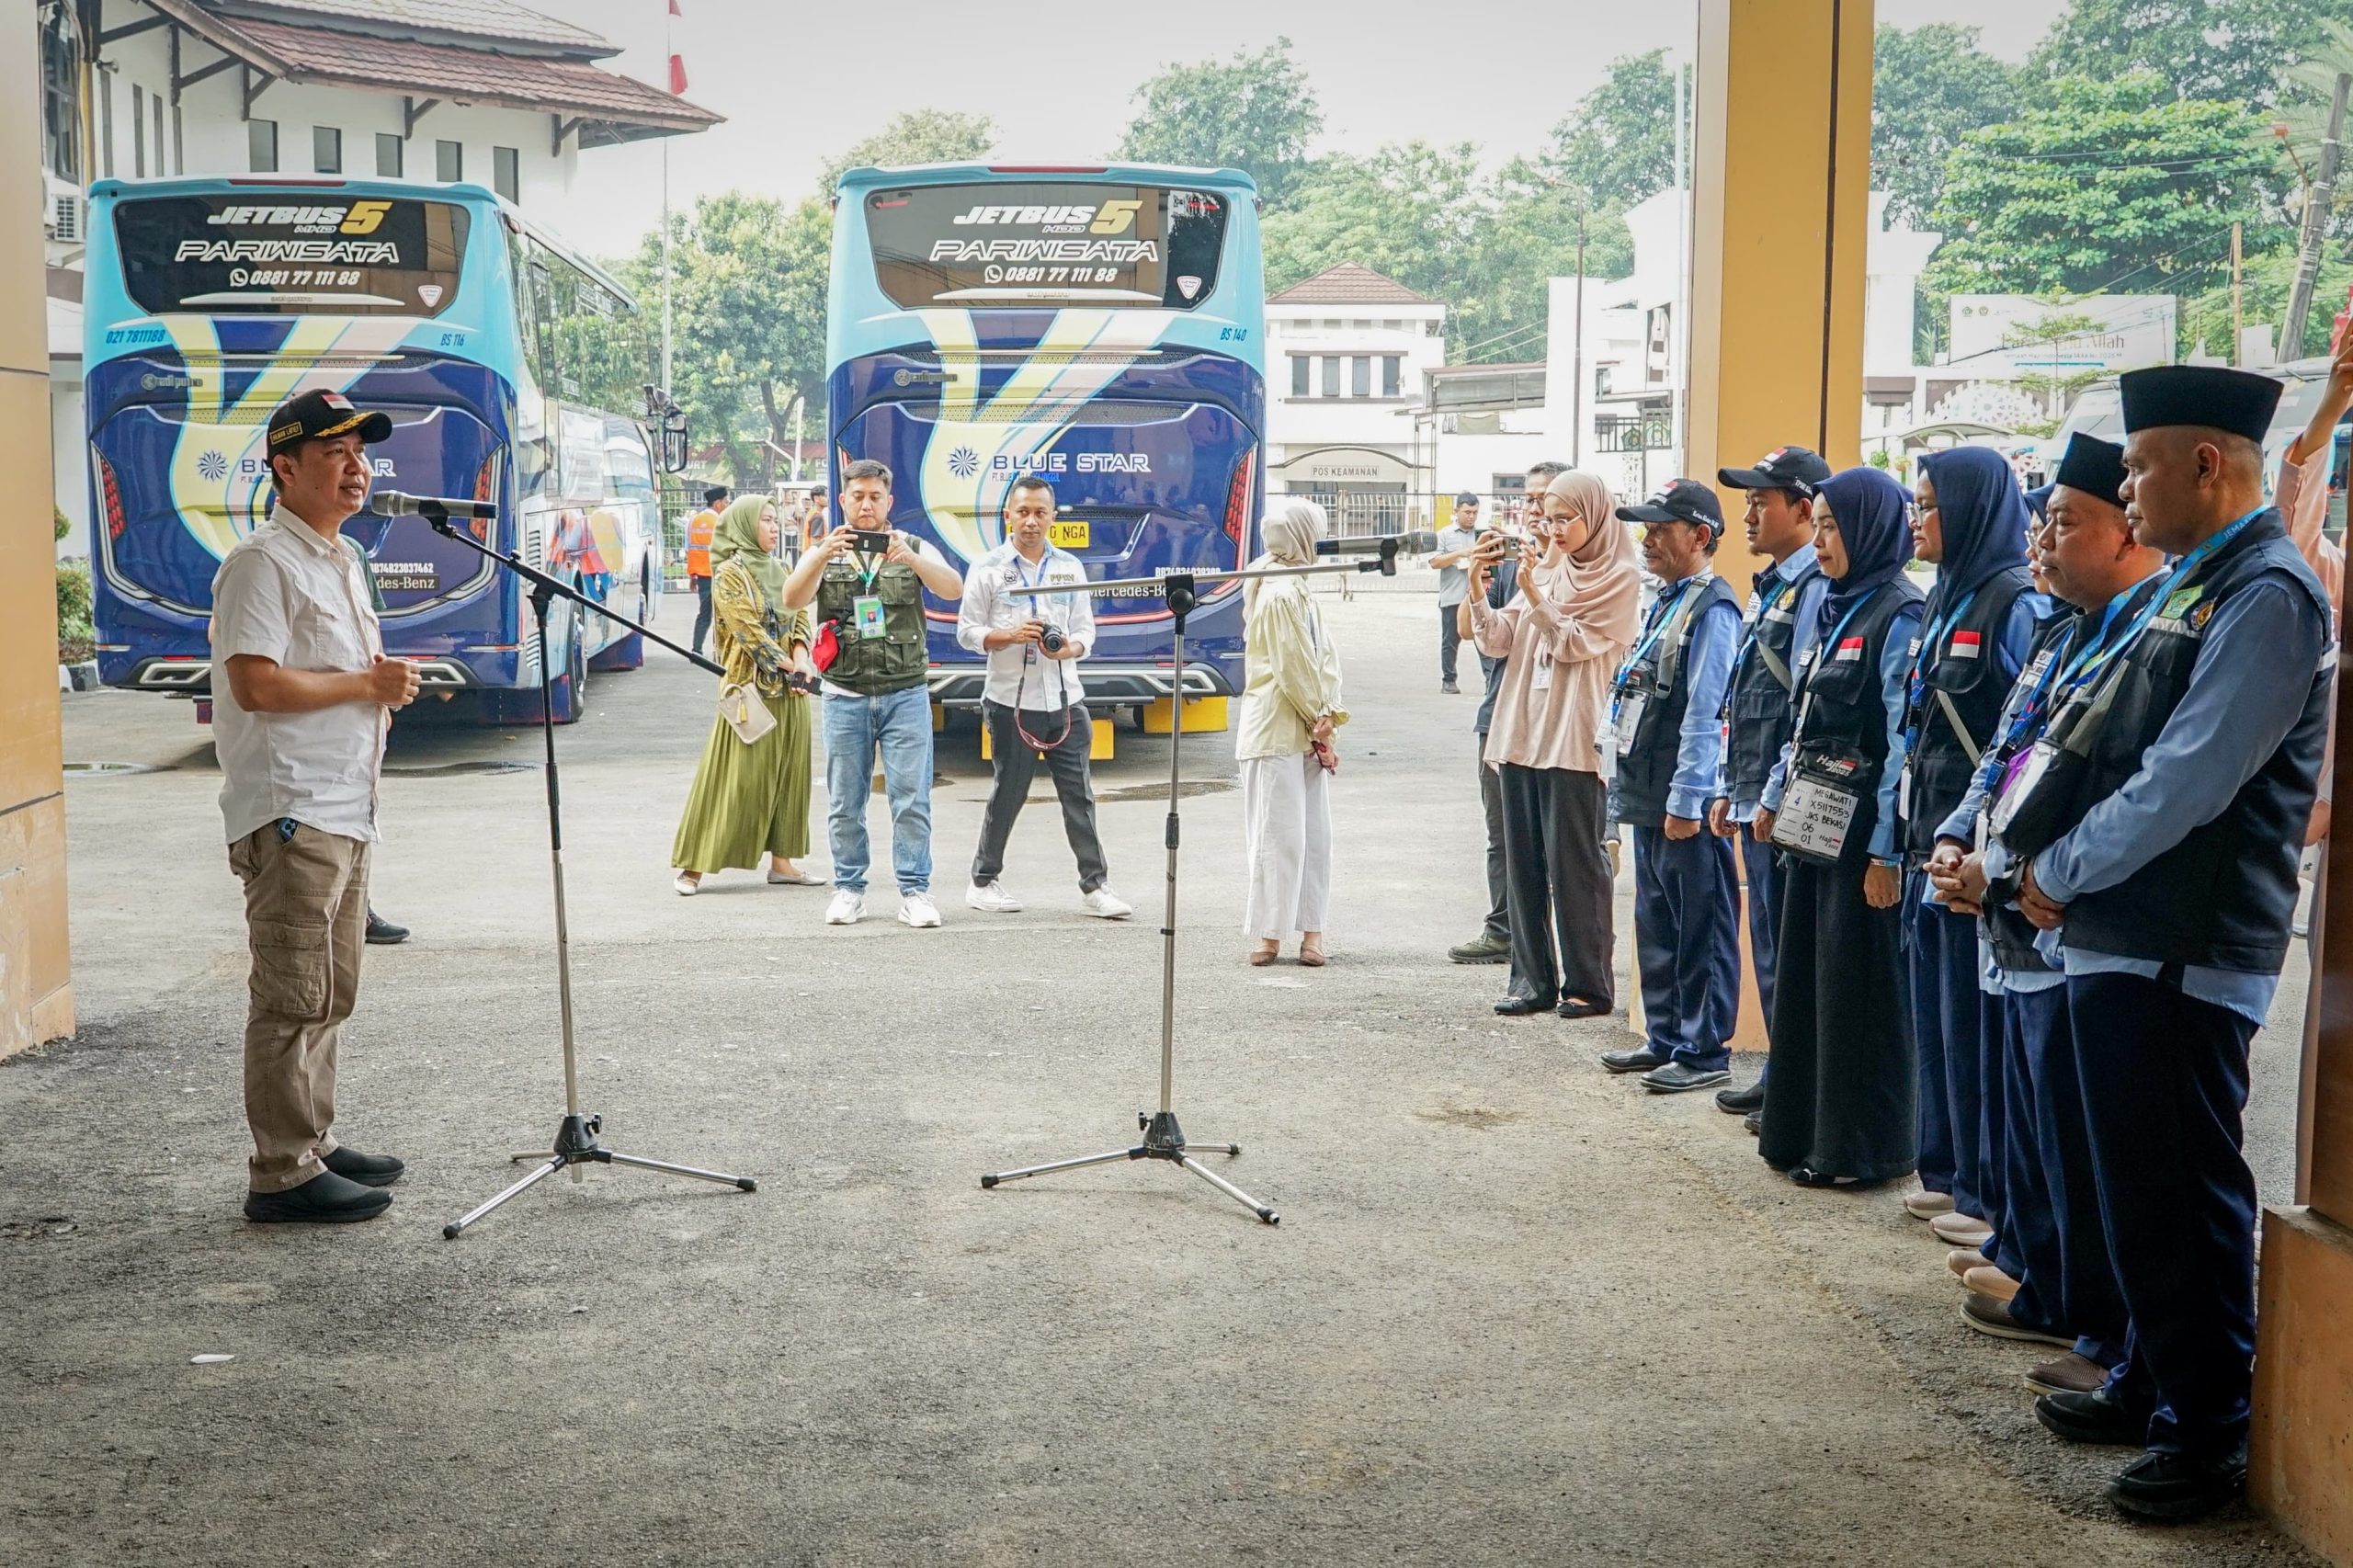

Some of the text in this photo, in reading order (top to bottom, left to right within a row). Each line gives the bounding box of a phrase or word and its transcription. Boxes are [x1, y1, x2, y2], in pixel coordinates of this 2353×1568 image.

[207, 200, 393, 235] JETBUS 5
[952, 199, 1143, 234] JETBUS 5
[174, 240, 400, 264] PARIWISATA
[928, 239, 1159, 263] PARIWISATA
[249, 270, 361, 286] 0881 77 111 88
[1005, 267, 1119, 283] 0881 77 111 88
[106, 329, 166, 344] 021 7811188
[440, 334, 466, 347] BS 116
[1220, 327, 1247, 342] BS 140
[242, 459, 272, 473] BL
[993, 453, 1153, 473] BLUE STAR
[1313, 467, 1378, 477] POS KEAMANAN
[377, 576, 436, 589] des-Benz
[1088, 585, 1167, 597] Mercedes-Be
[1814, 788, 1852, 807] MEGAWATI
